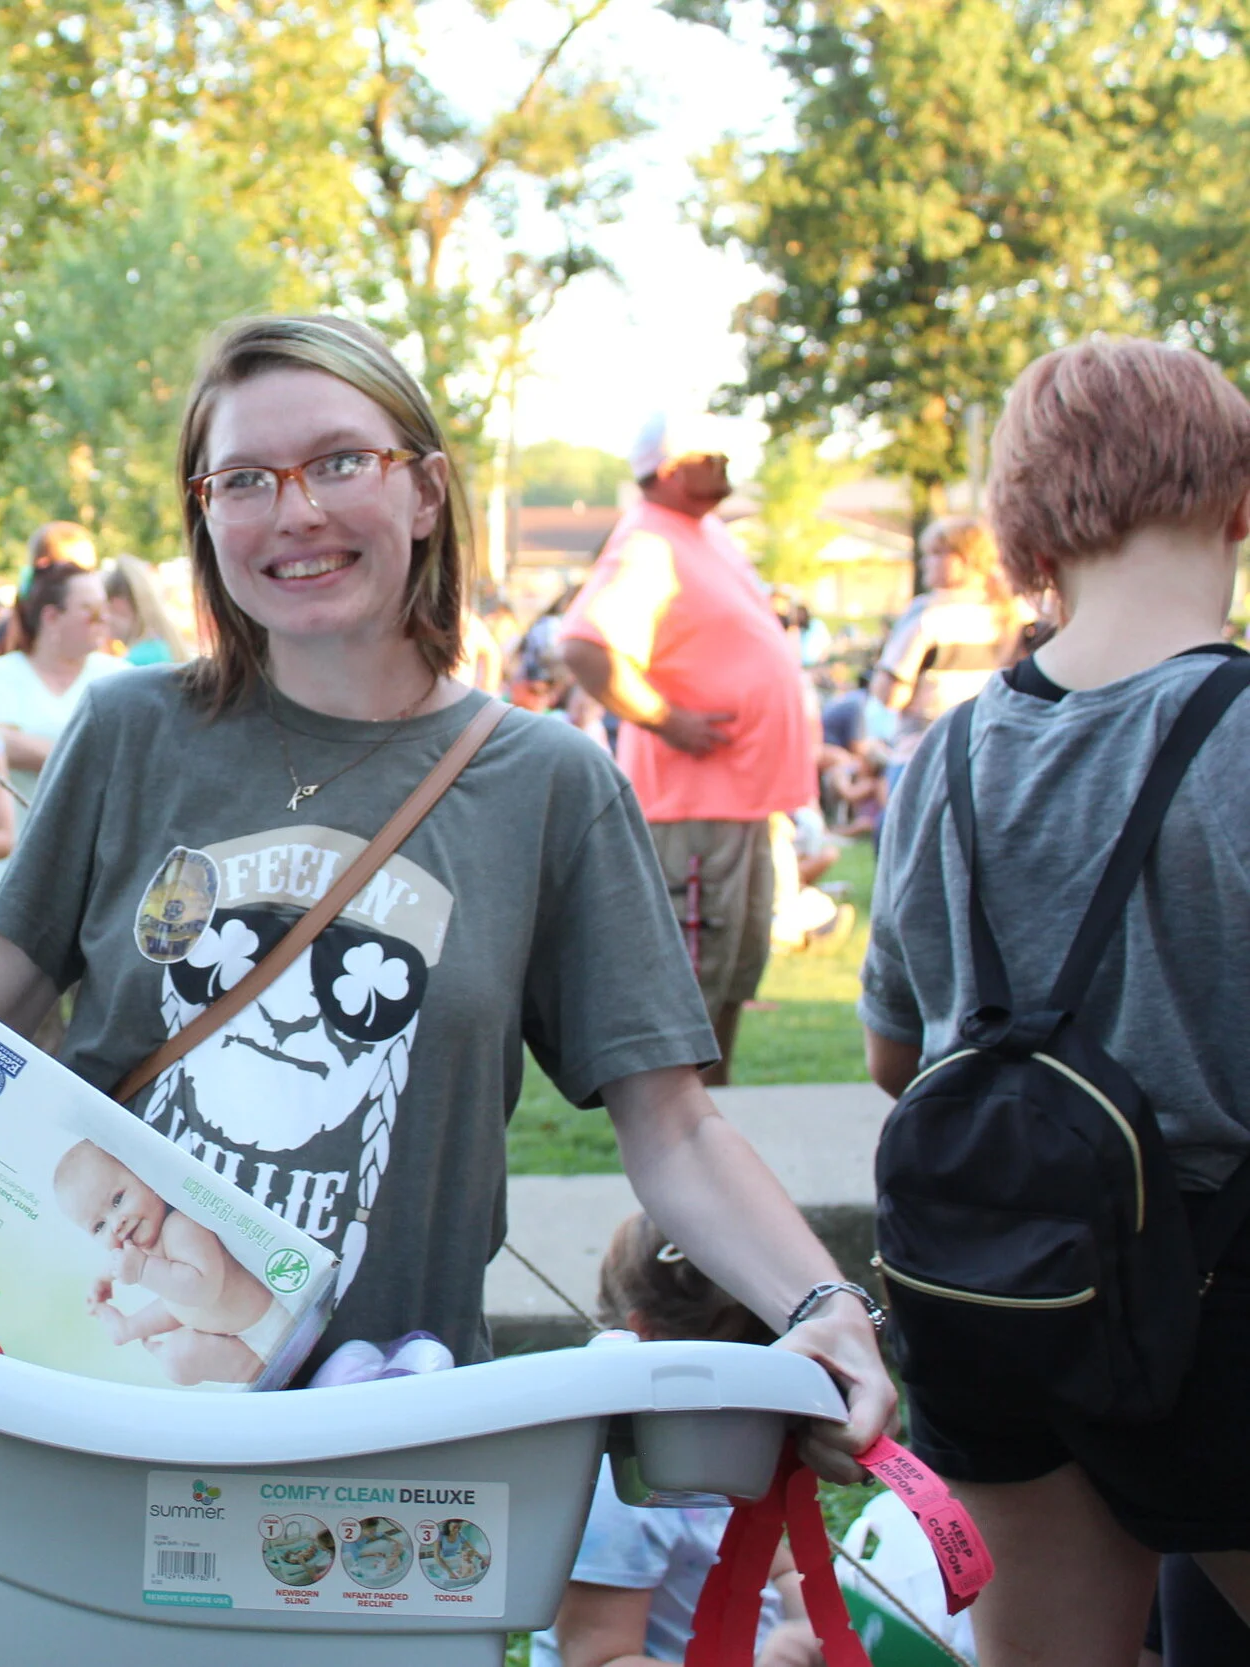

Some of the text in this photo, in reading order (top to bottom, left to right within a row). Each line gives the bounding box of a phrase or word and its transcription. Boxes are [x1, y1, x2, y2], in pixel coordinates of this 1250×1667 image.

[222, 843, 419, 924] FEELN'
[894, 1457, 924, 1480] KEEP
[260, 1484, 475, 1505] COMFY CLEAN DELUXE
[267, 1525, 274, 1537] 1
[345, 1528, 353, 1539] 2
[423, 1530, 431, 1542] 3
[948, 1519, 973, 1557] KEEP
[929, 1518, 963, 1575] COUPON
[276, 1589, 320, 1598] NEWBORN
[342, 1592, 409, 1601] INFANT PADDED
[434, 1594, 473, 1603] TODDLER
[285, 1597, 310, 1606] SLING
[357, 1600, 393, 1609] RECLINE
